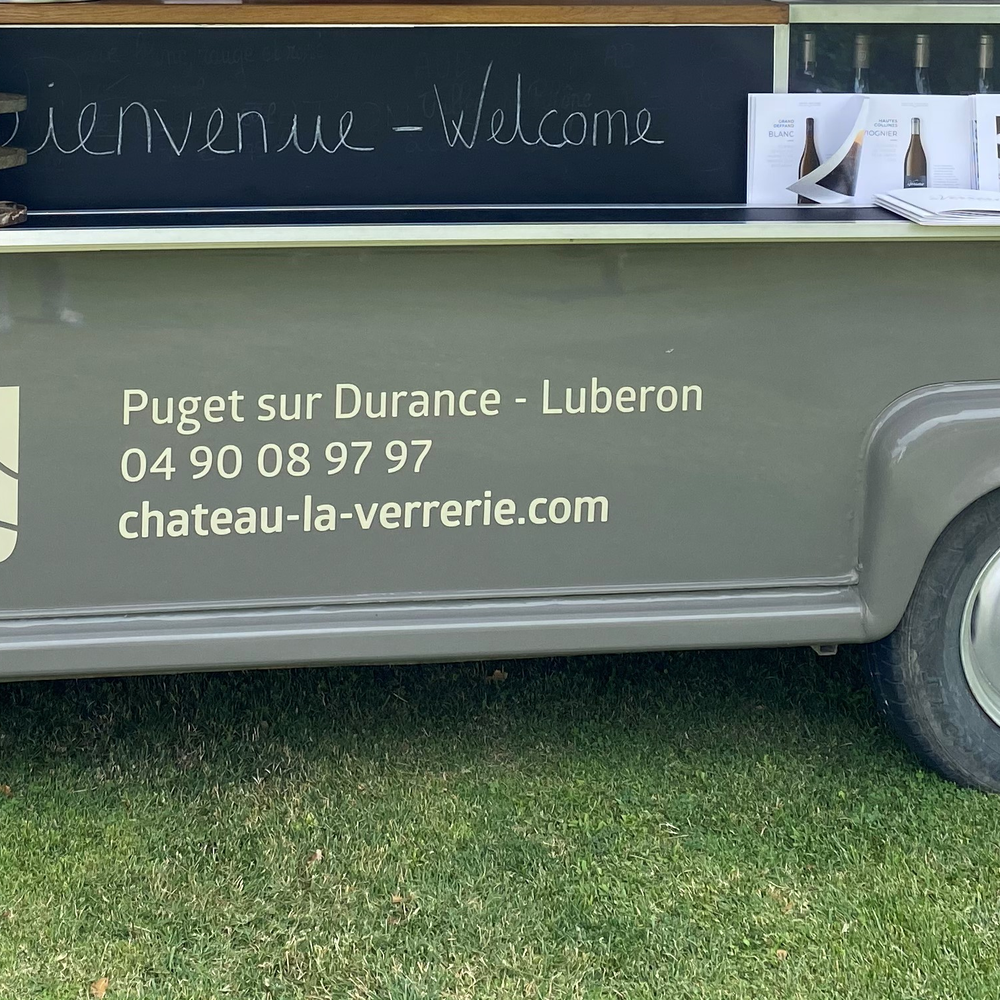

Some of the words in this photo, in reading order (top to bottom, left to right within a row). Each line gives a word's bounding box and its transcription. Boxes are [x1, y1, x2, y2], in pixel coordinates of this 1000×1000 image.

[433, 60, 666, 150] Welcome
[768, 130, 795, 138] BLANC
[122, 389, 245, 435] Puget
[256, 392, 323, 422] sur
[334, 383, 501, 419] Durance
[541, 376, 703, 415] Luberon
[120, 447, 176, 483] 04
[189, 444, 243, 480] 90
[256, 442, 311, 478] 08
[324, 441, 373, 475] 97
[384, 439, 433, 473] 97
[117, 490, 609, 539] chateau-la-verrerie.com
